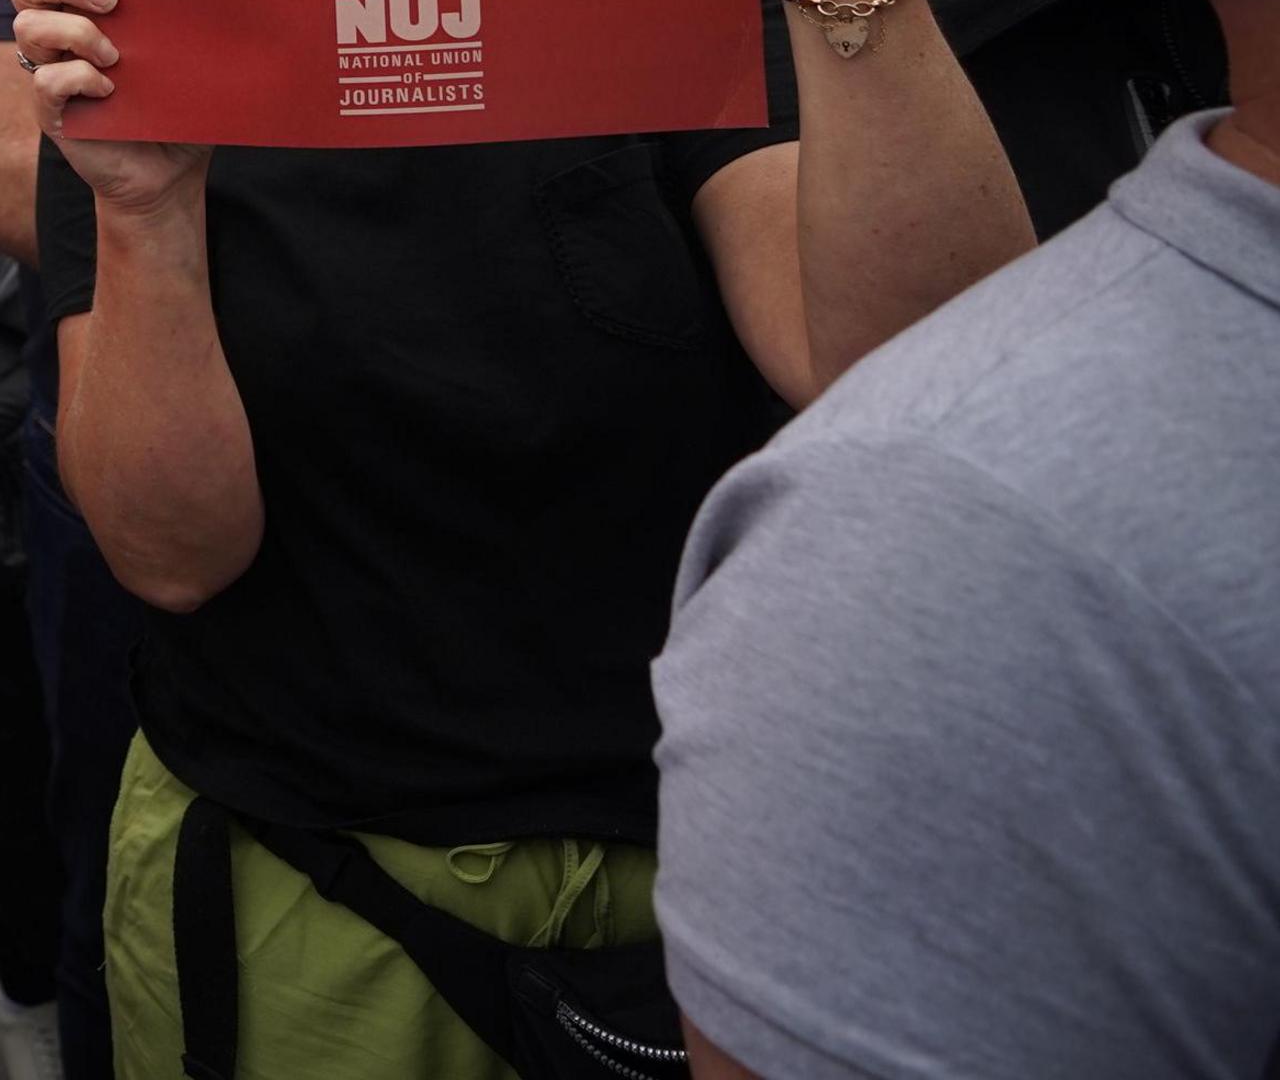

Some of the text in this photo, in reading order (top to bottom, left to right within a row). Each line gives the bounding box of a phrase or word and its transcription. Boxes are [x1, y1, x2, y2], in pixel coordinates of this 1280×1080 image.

[339, 50, 482, 69] NATIONAL UNION
[403, 72, 422, 84] OF
[340, 84, 484, 106] JOURNALISTS
